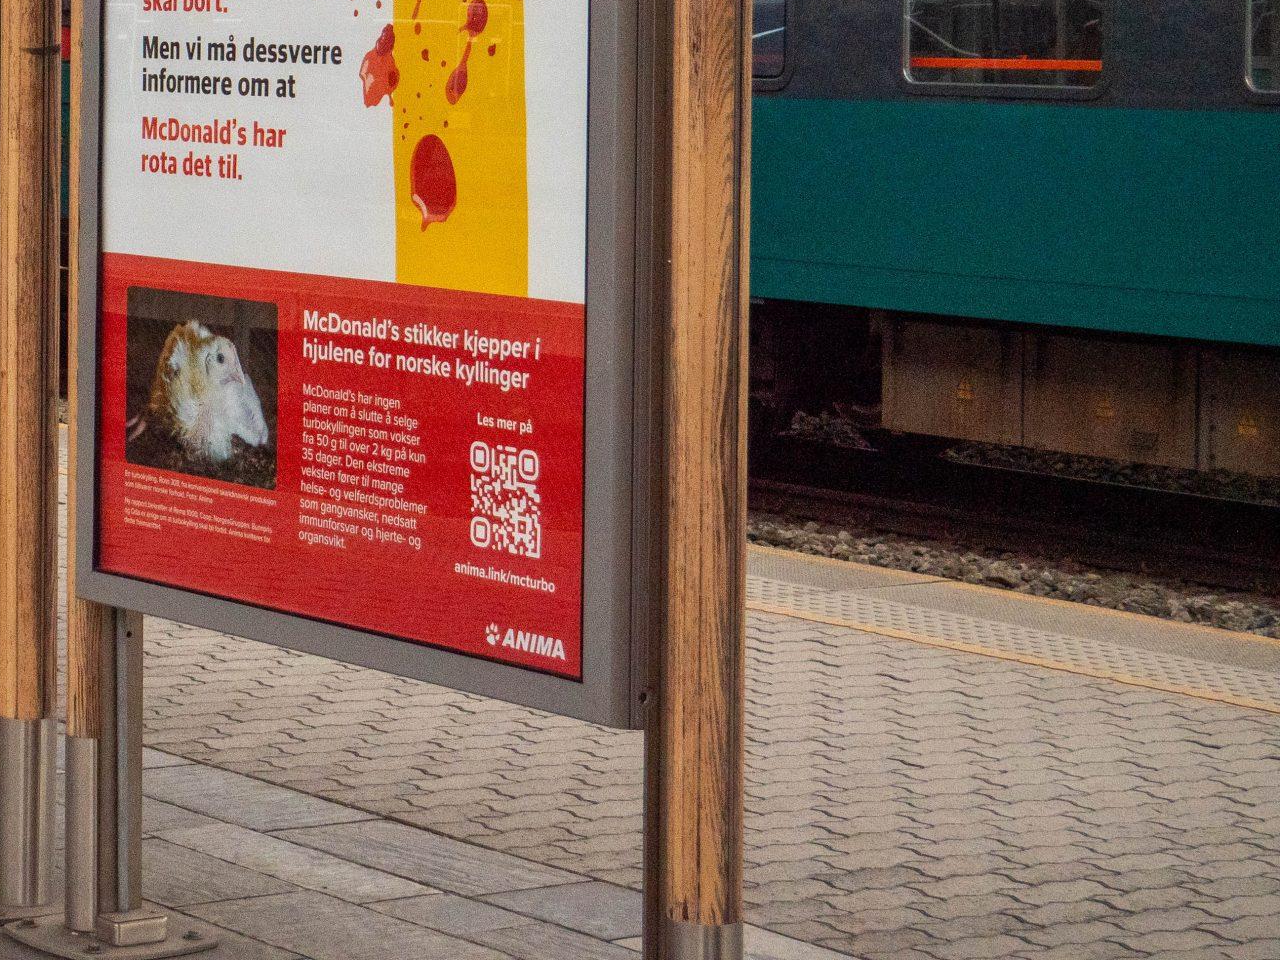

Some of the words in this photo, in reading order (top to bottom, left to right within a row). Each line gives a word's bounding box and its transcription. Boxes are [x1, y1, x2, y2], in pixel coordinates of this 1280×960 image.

[143, 36, 180, 60] Men
[186, 36, 201, 61] vi
[207, 35, 237, 62] må
[243, 41, 342, 64] dessverre
[142, 69, 232, 95] informere
[238, 74, 269, 96] om
[276, 74, 295, 98] at
[142, 117, 247, 146] McDonald's
[253, 121, 286, 147] har
[141, 152, 176, 176] rota
[183, 152, 211, 178] det
[218, 155, 243, 180] til.
[303, 309, 399, 342] McDonald's
[404, 324, 458, 350] stikker
[463, 329, 531, 363] kjepper
[535, 337, 540, 360] i
[302, 338, 363, 372] hjulene
[368, 347, 393, 367] for
[396, 350, 450, 376] norske
[455, 356, 529, 391] kyllinger
[477, 412, 496, 428] Les
[499, 416, 518, 430] mer
[520, 416, 532, 435] på
[454, 561, 556, 593] anima.link/mcturbo
[502, 629, 566, 660] ANIMA
